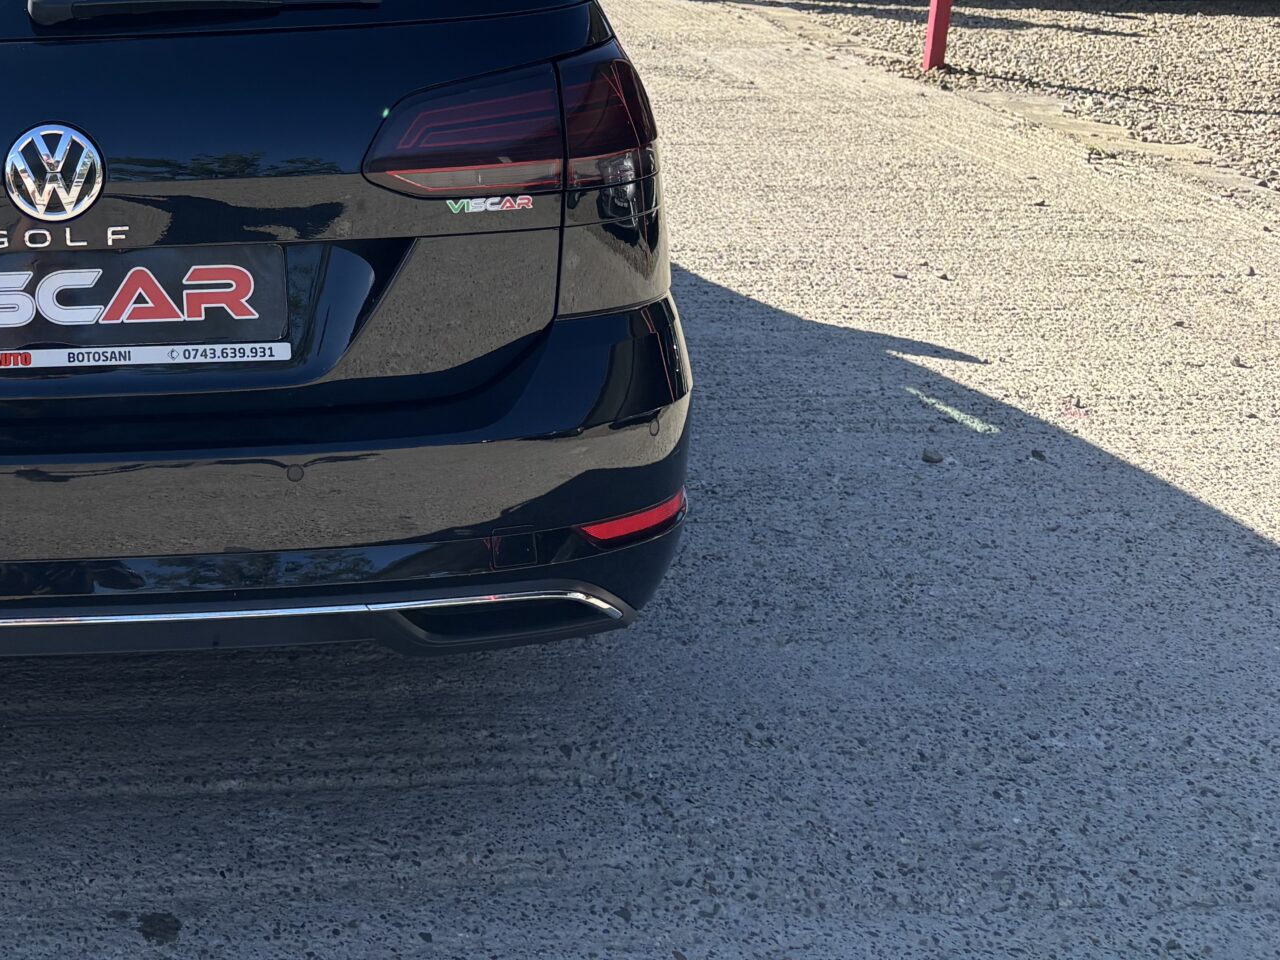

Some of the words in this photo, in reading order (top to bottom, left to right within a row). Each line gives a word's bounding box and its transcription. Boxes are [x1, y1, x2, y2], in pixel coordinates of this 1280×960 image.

[446, 195, 533, 213] VISCAR
[67, 350, 132, 363] BOTOSANI
[182, 346, 276, 360] 0743.639.931
